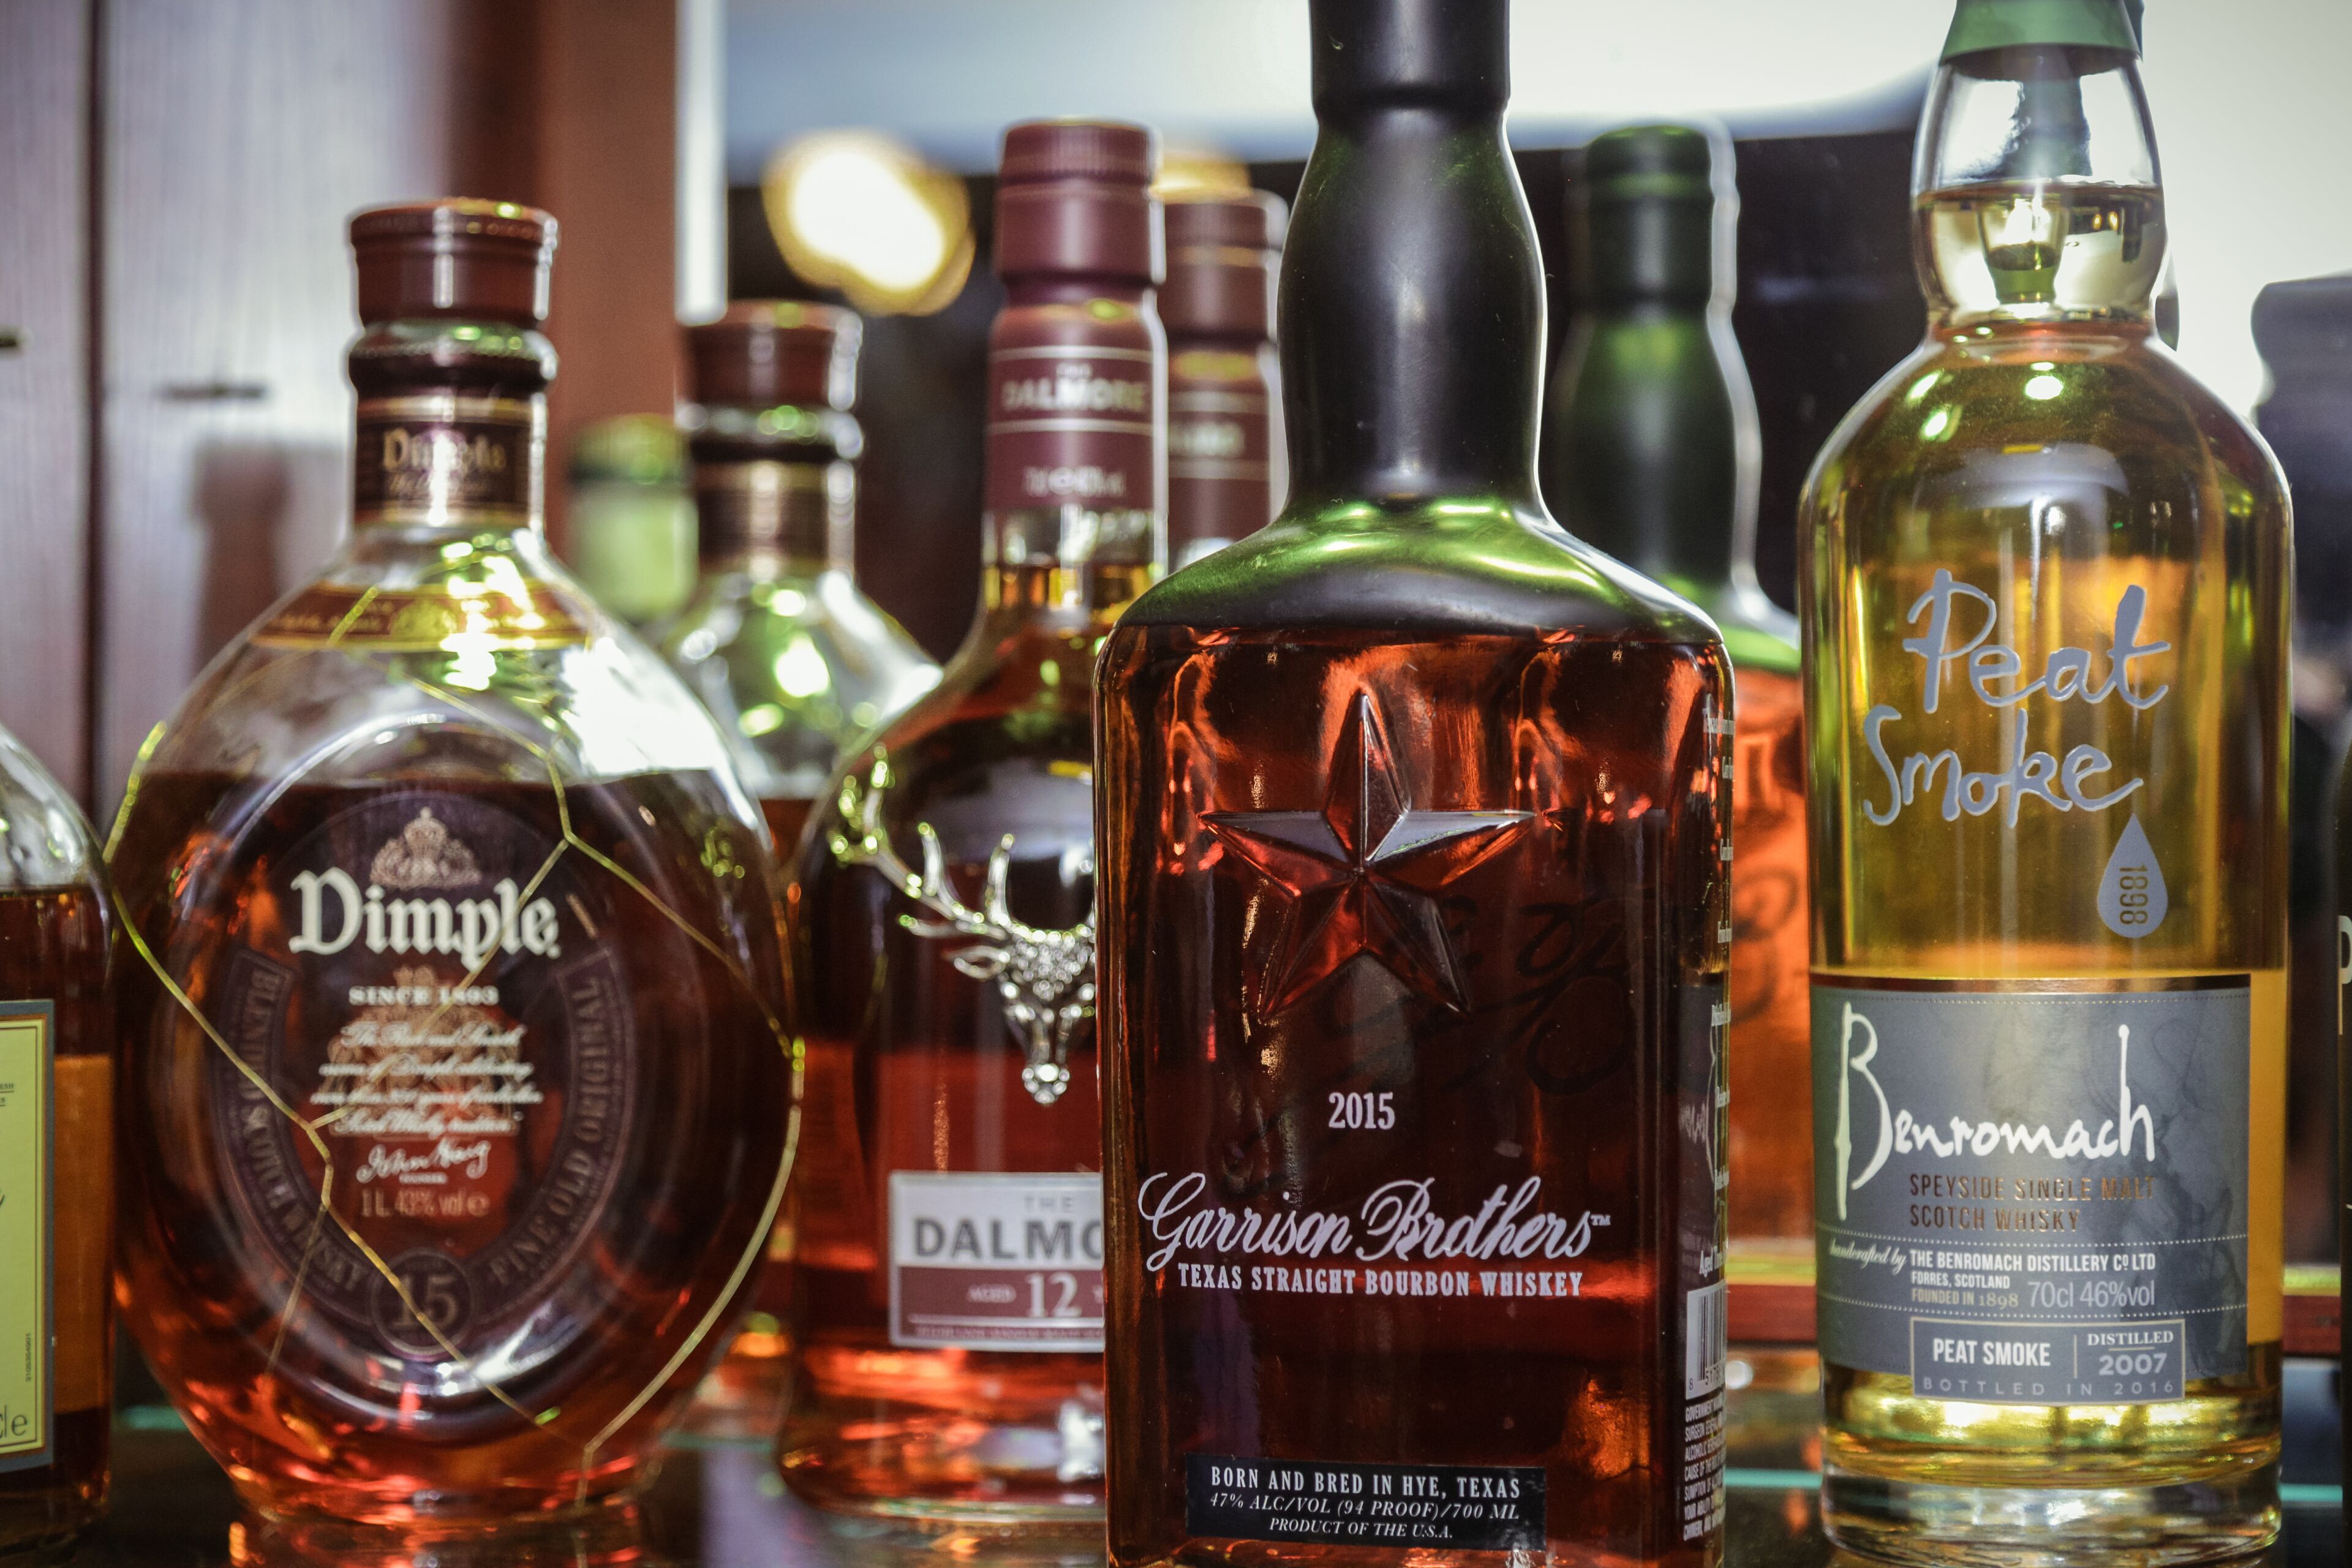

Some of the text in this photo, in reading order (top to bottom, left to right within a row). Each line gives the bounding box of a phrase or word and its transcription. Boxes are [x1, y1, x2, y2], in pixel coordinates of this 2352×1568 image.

[1903, 568, 2171, 714] Peat
[1863, 704, 2143, 828] Smoke
[2119, 864, 2149, 925] 1898
[288, 867, 560, 974] Dimple
[349, 986, 431, 1006] SINCE
[1329, 1092, 1395, 1129] 2015
[1834, 1001, 2155, 1221] Benromach
[1910, 1173, 2155, 1202] SPEYSIDE SINGLE MALT
[1137, 1172, 1352, 1272] Garrison
[1910, 1204, 2081, 1232] SCOTCH WHISKY
[1828, 1237, 1890, 1269] handcrafted
[1891, 1245, 1907, 1275] by
[1910, 1249, 1934, 1268] THE
[1937, 1251, 2022, 1272] BENROMACH
[2027, 1254, 2109, 1272] DISTILLERY
[2132, 1253, 2155, 1270] LTD
[1027, 1272, 1082, 1318] 12
[1178, 1263, 1583, 1297] TEXAS STRAIGHT BOURBON WHISKEY
[1912, 1271, 2011, 1289] FORRES, SCOTLAND
[2027, 1281, 2074, 1308] 70cl
[393, 1274, 458, 1329] 15
[1912, 1288, 2019, 1310] FOUNDED IN 1898
[1932, 1338, 2051, 1366] PEAT SMOKE
[2087, 1330, 2174, 1346] DISTILLED
[2098, 1352, 2168, 1376] 2007
[1923, 1378, 2173, 1396] BOTTLED IN 2016
[1211, 1466, 1520, 1499] BORN AND BRED IN HYE, TEXAS
[1210, 1493, 1520, 1520] 47% ALC/VOL (94 PROOF)/700 ML
[1269, 1518, 1453, 1539] PRODUCT OF THE U.S.A.
